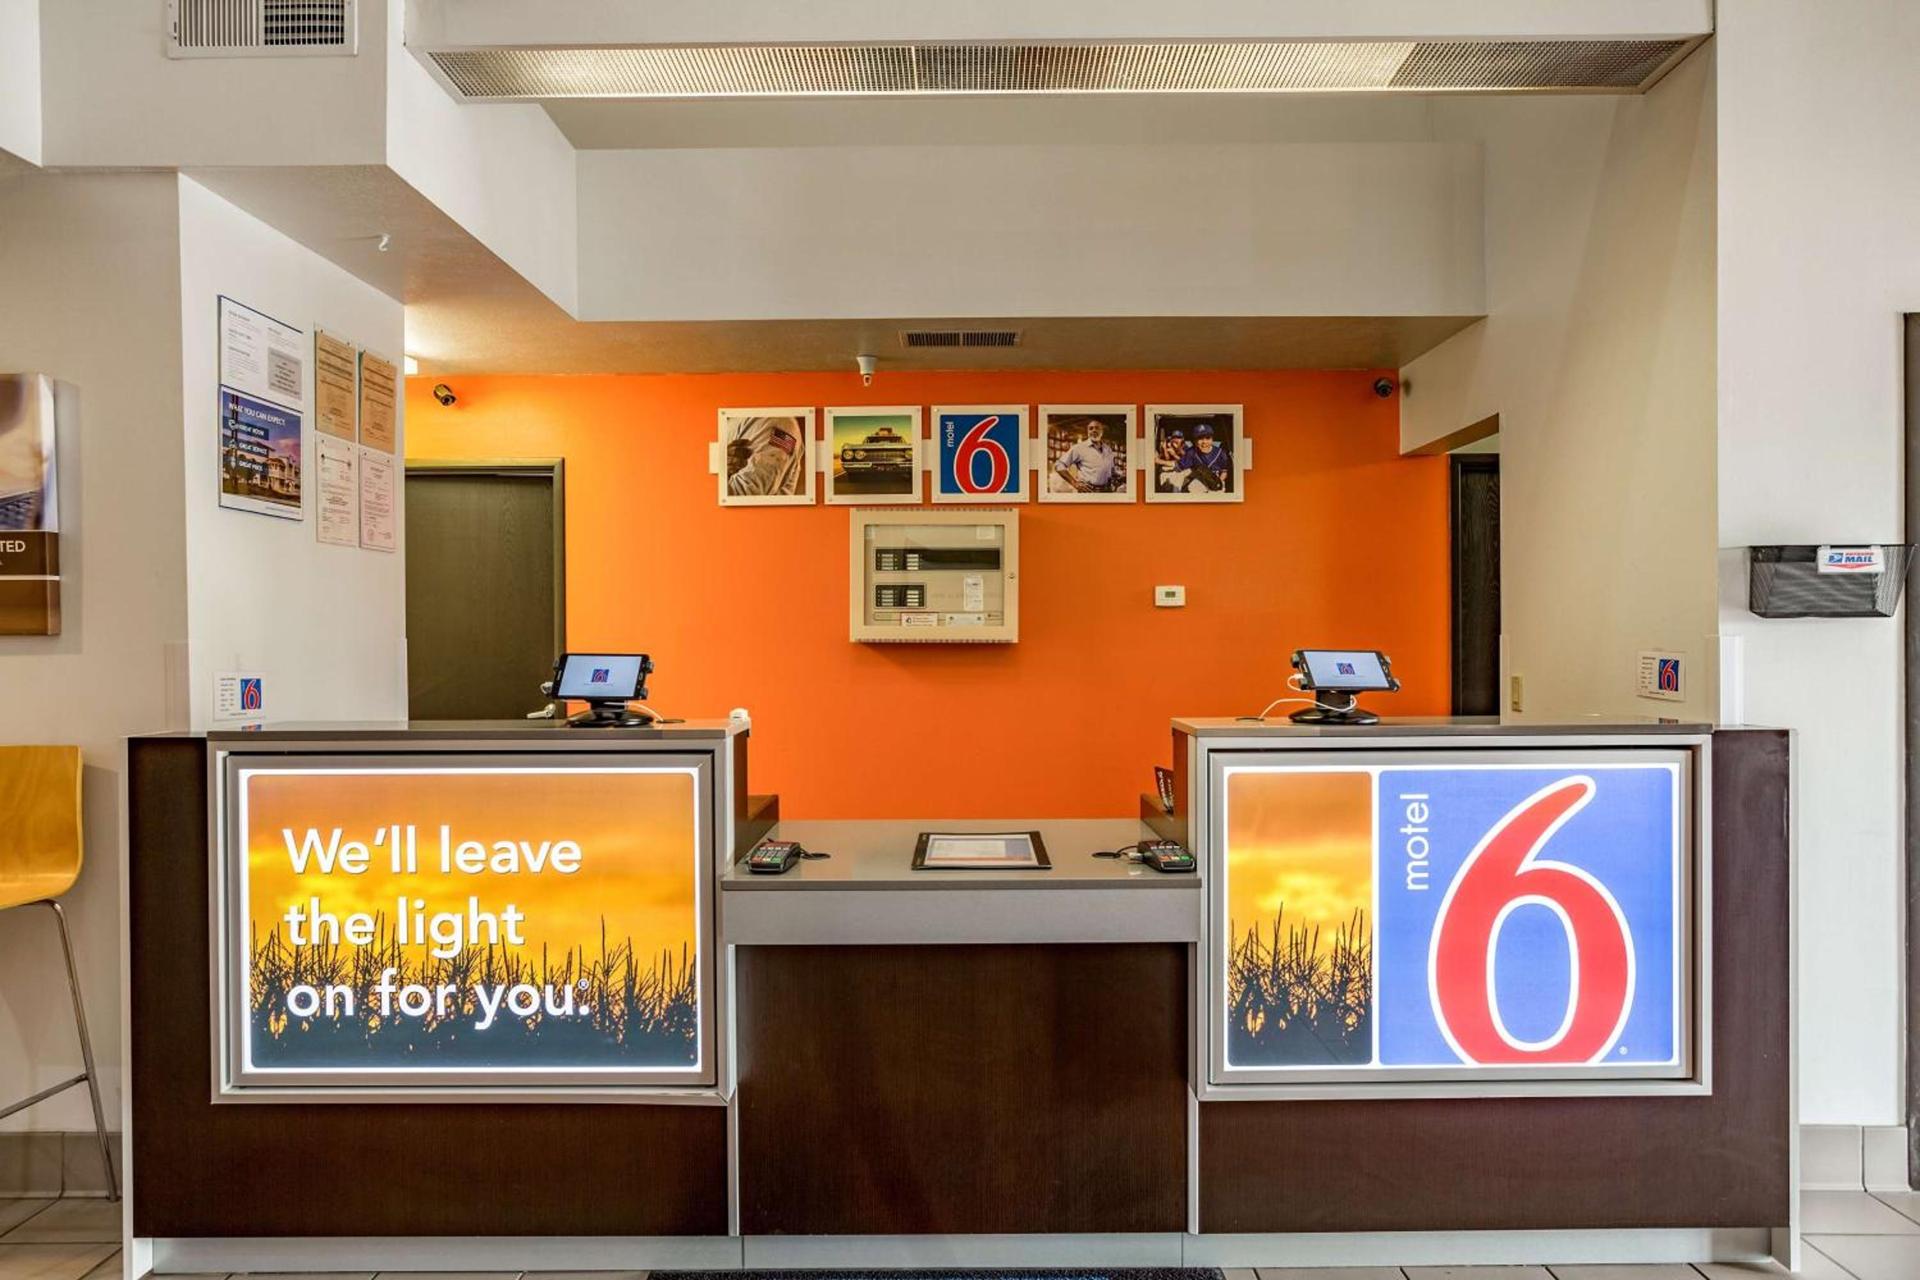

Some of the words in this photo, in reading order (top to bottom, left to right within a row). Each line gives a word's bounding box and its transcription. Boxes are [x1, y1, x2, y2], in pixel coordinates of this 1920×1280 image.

[244, 407, 256, 417] YOU
[256, 411, 267, 420] CAN
[945, 421, 955, 448] motel
[953, 415, 1011, 494] 6
[282, 825, 415, 873] We'll
[441, 825, 582, 873] leave
[285, 898, 375, 945] the
[399, 897, 525, 960] light
[1400, 793, 1429, 890] motel
[1428, 774, 1636, 1065] 6
[287, 984, 354, 1017] on
[375, 968, 456, 1016] for
